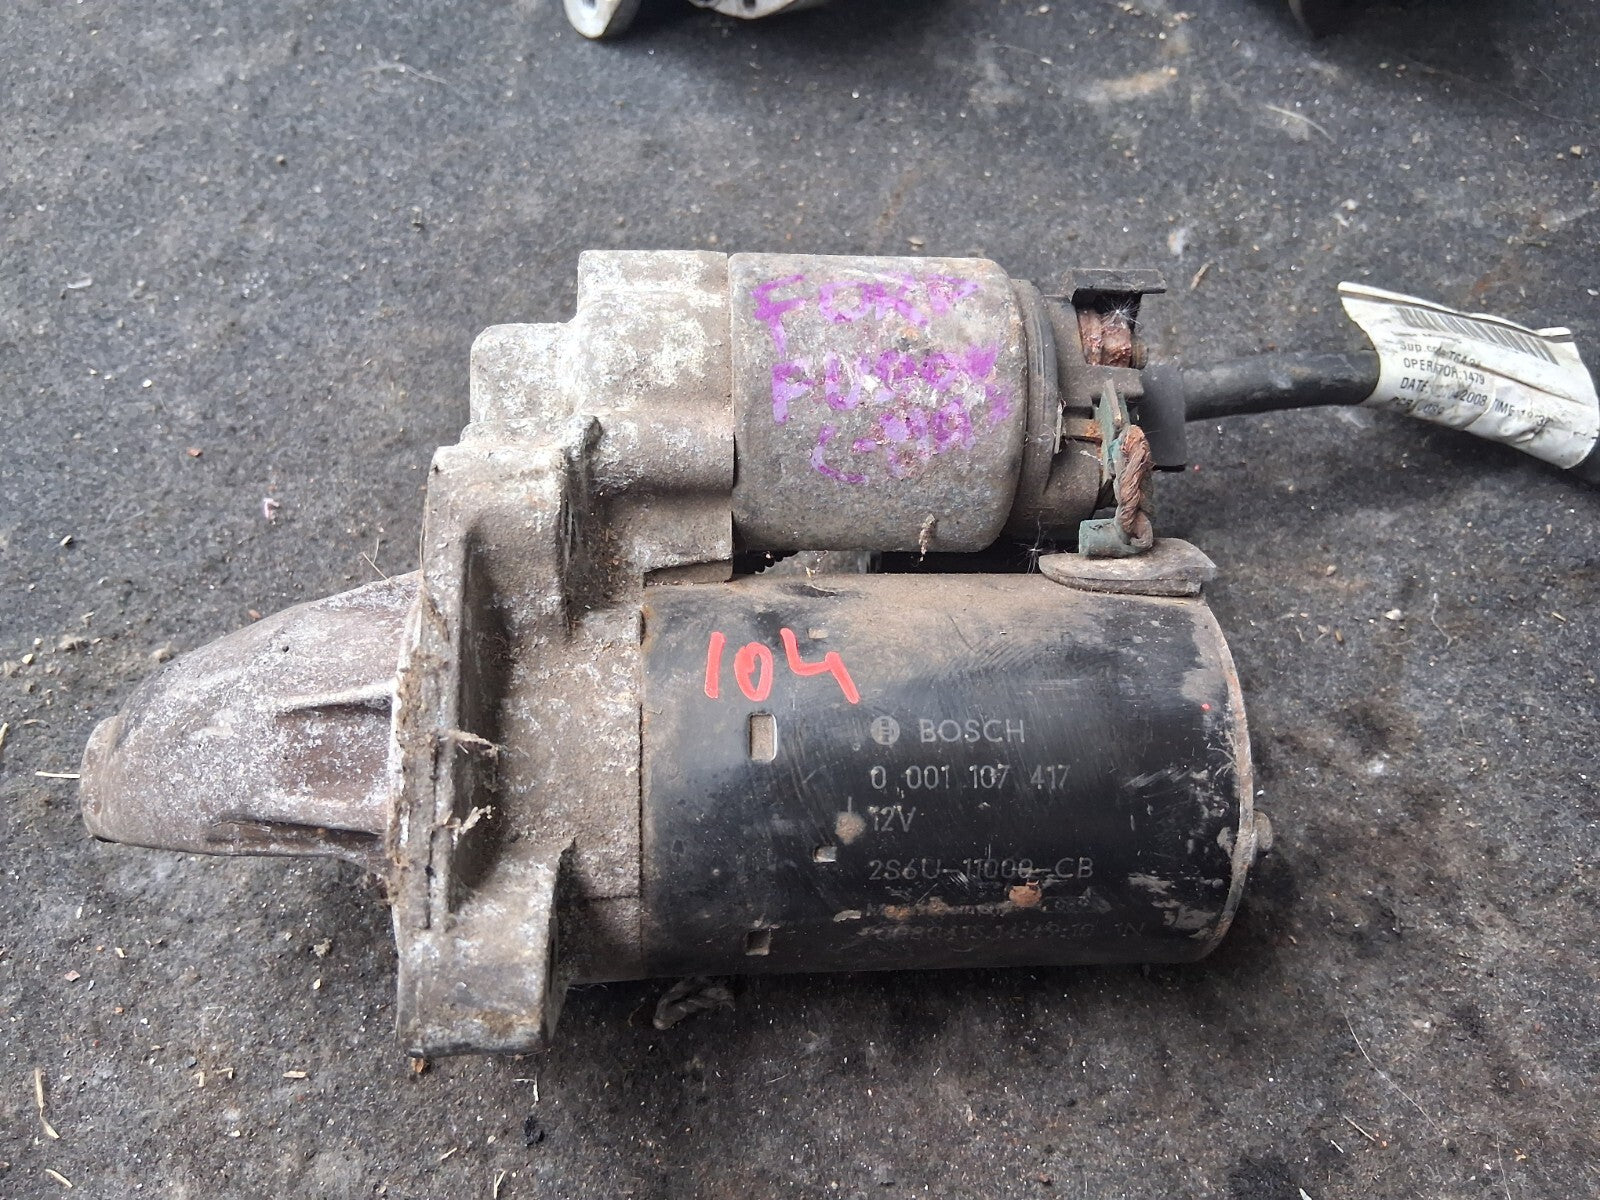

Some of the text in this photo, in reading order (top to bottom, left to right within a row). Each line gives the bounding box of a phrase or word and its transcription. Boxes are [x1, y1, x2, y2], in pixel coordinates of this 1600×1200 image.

[704, 627, 861, 705] 104
[918, 717, 1026, 743] BOSCH
[870, 763, 1071, 790] 0 001 107 417
[869, 804, 917, 833] 12V
